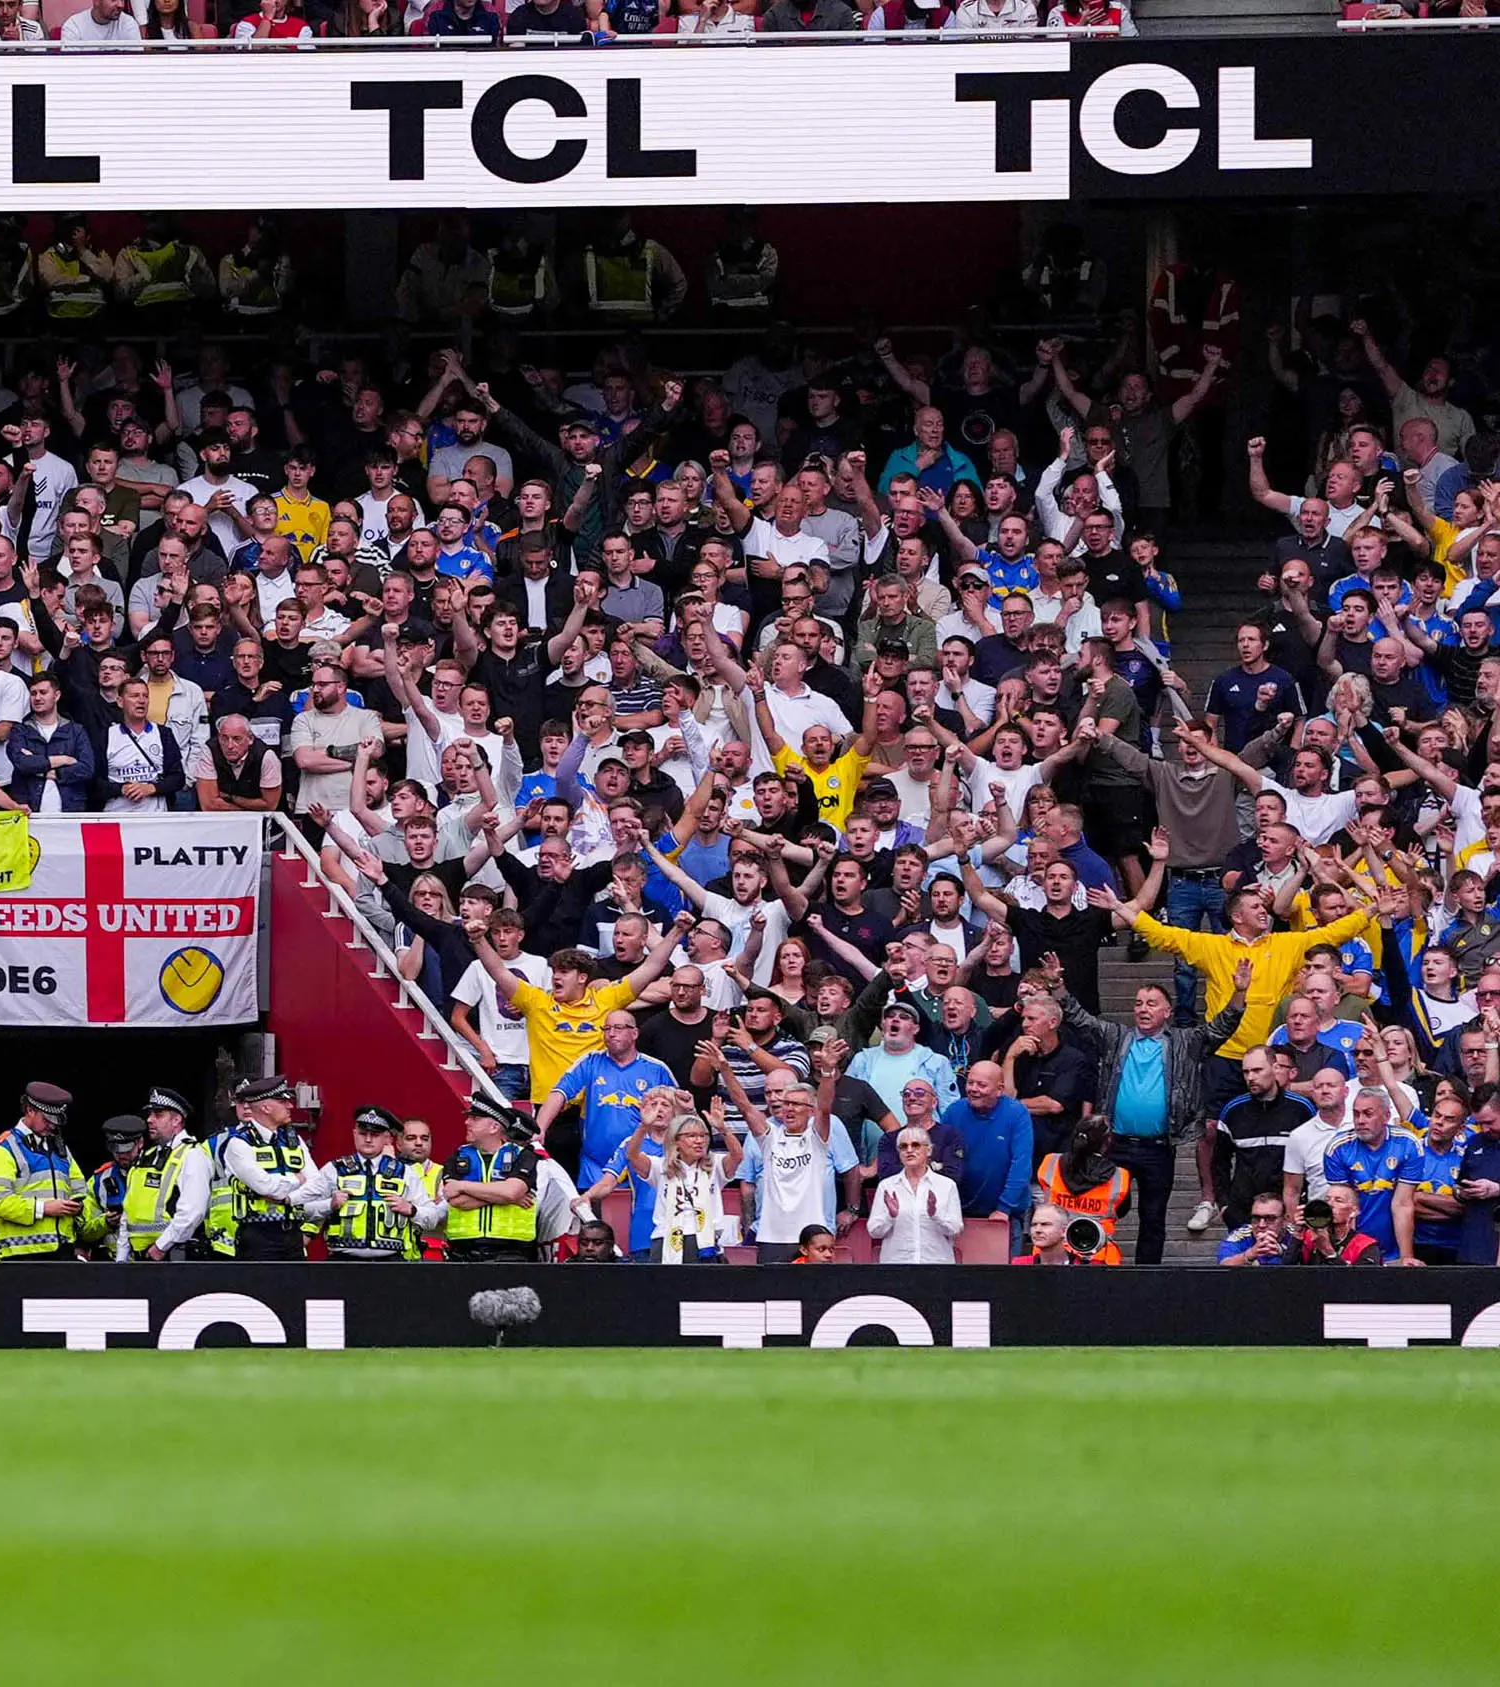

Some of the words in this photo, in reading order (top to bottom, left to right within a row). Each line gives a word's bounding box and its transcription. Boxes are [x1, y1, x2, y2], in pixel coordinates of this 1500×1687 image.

[350, 73, 697, 184] TCL
[955, 62, 1312, 175] TCL
[134, 846, 248, 865] PLATTY
[97, 903, 242, 932] UNITED
[1056, 1193, 1102, 1212] STEWARD
